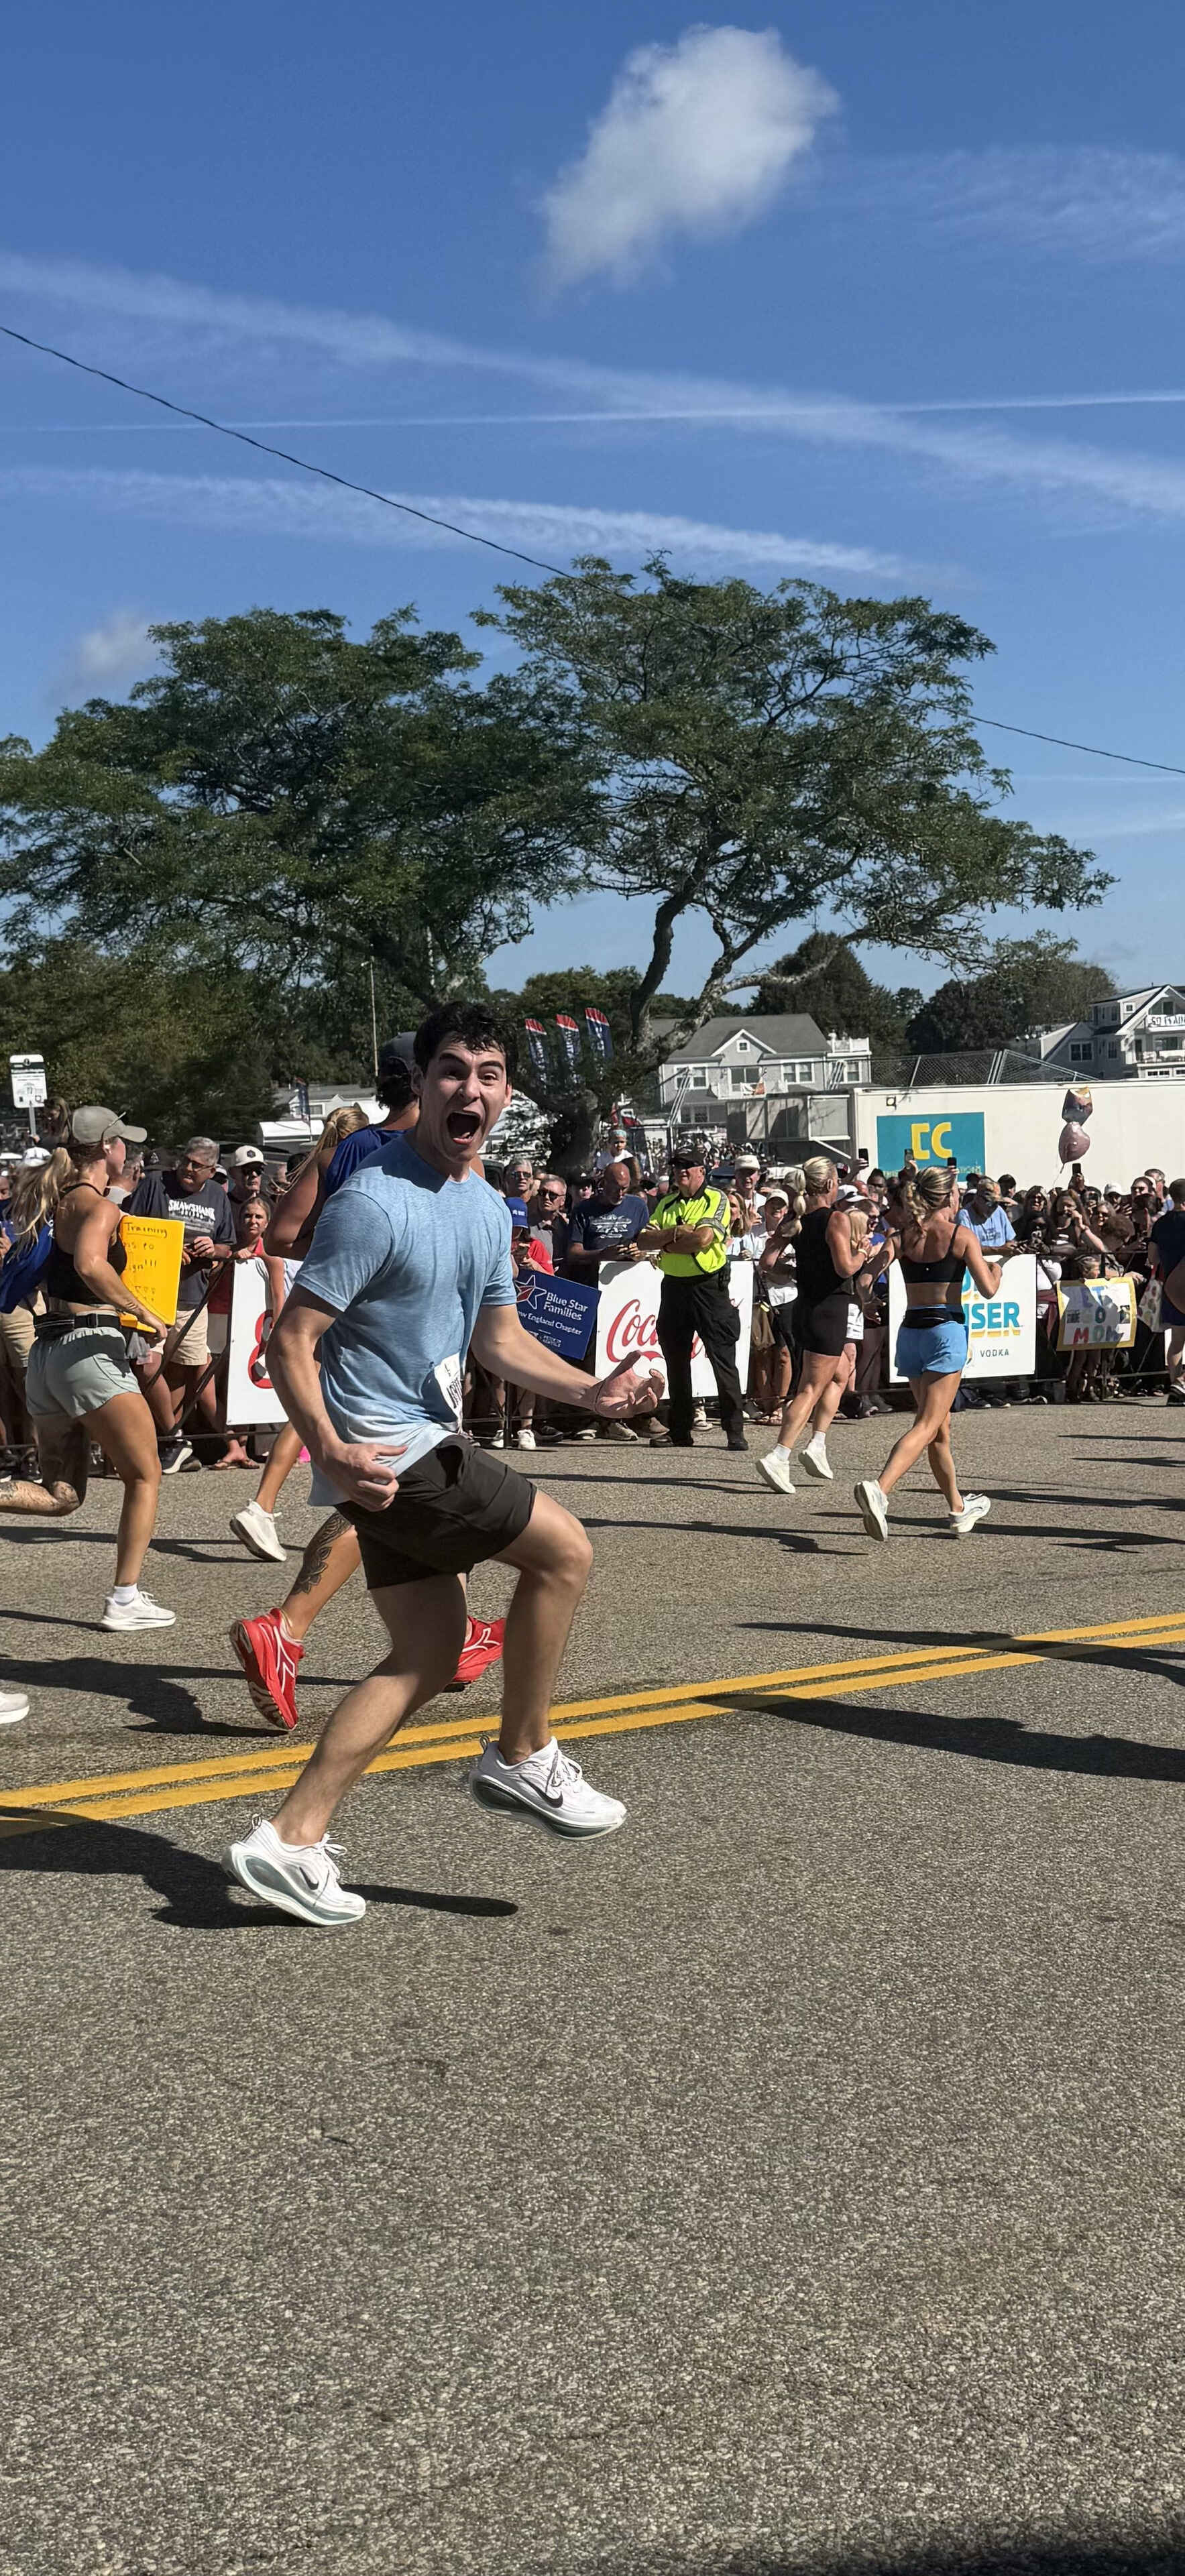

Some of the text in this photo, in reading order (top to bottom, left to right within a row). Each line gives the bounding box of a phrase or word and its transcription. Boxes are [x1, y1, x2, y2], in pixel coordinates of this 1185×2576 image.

[123, 1222, 167, 1238] Training
[543, 1301, 582, 1321] Families
[546, 1292, 588, 1312] Blue Star
[528, 1313, 554, 1327] England
[555, 1322, 583, 1335] Chapter
[963, 1302, 1020, 1330] ISER
[980, 1349, 1009, 1358] VODKA
